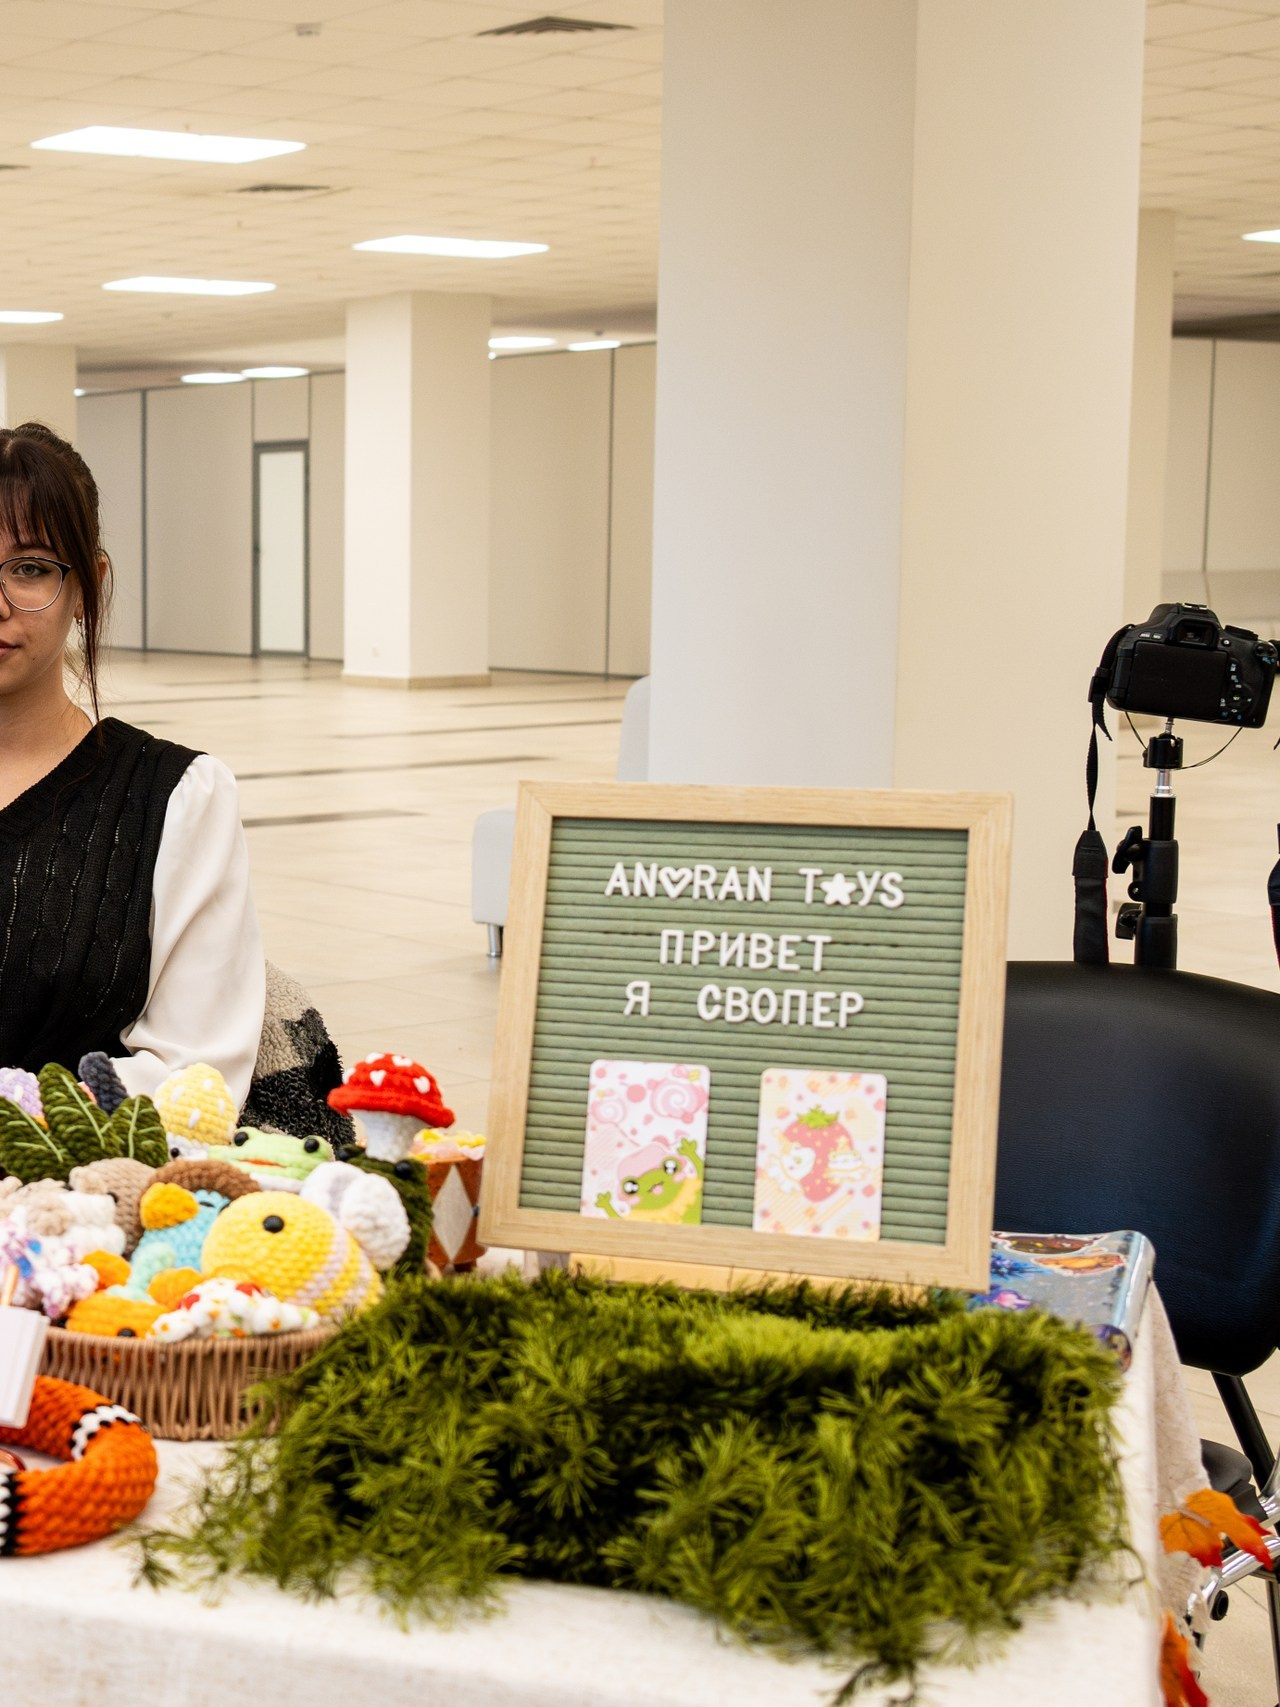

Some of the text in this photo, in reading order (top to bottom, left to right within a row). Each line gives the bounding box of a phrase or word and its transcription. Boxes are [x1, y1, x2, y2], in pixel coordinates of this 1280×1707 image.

[659, 928, 833, 972] ПРИВЕТ
[623, 981, 865, 1028] Я СВОПЕР
